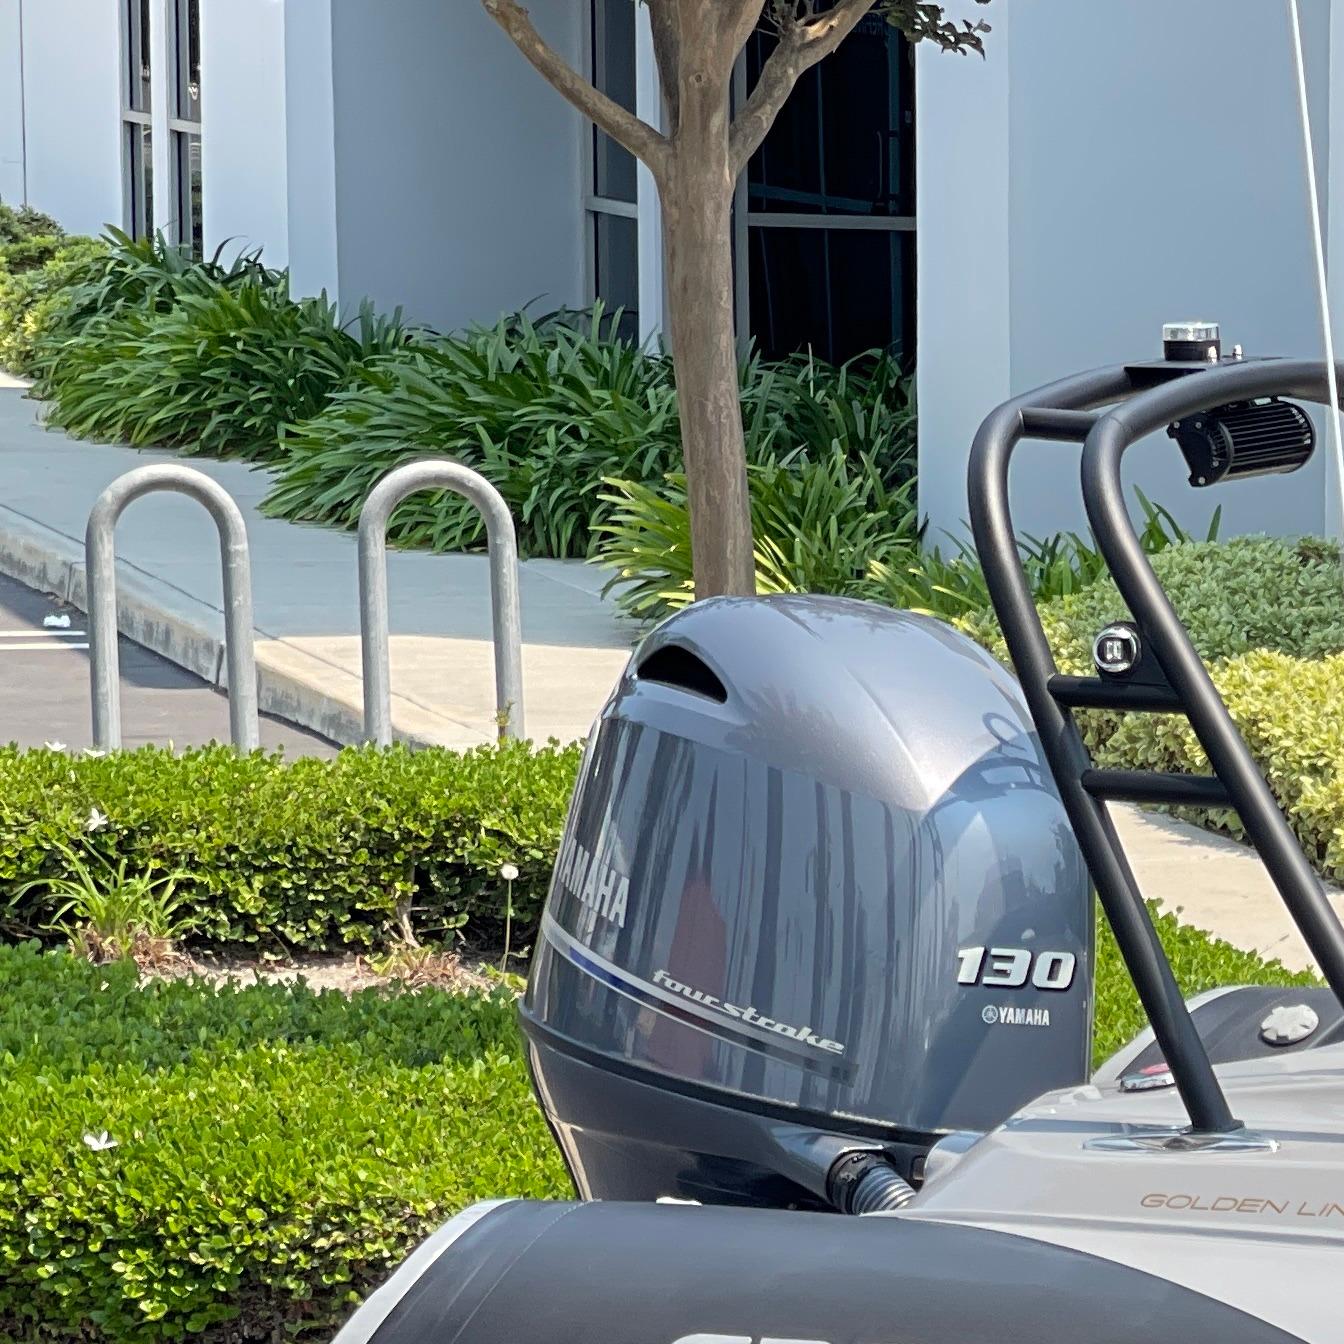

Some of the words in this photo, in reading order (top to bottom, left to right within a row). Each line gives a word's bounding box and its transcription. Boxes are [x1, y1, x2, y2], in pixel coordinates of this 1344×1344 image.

[957, 946, 1077, 990] 130
[999, 1006, 1050, 1026] YAMAHA
[1140, 1193, 1290, 1214] GOLDEN
